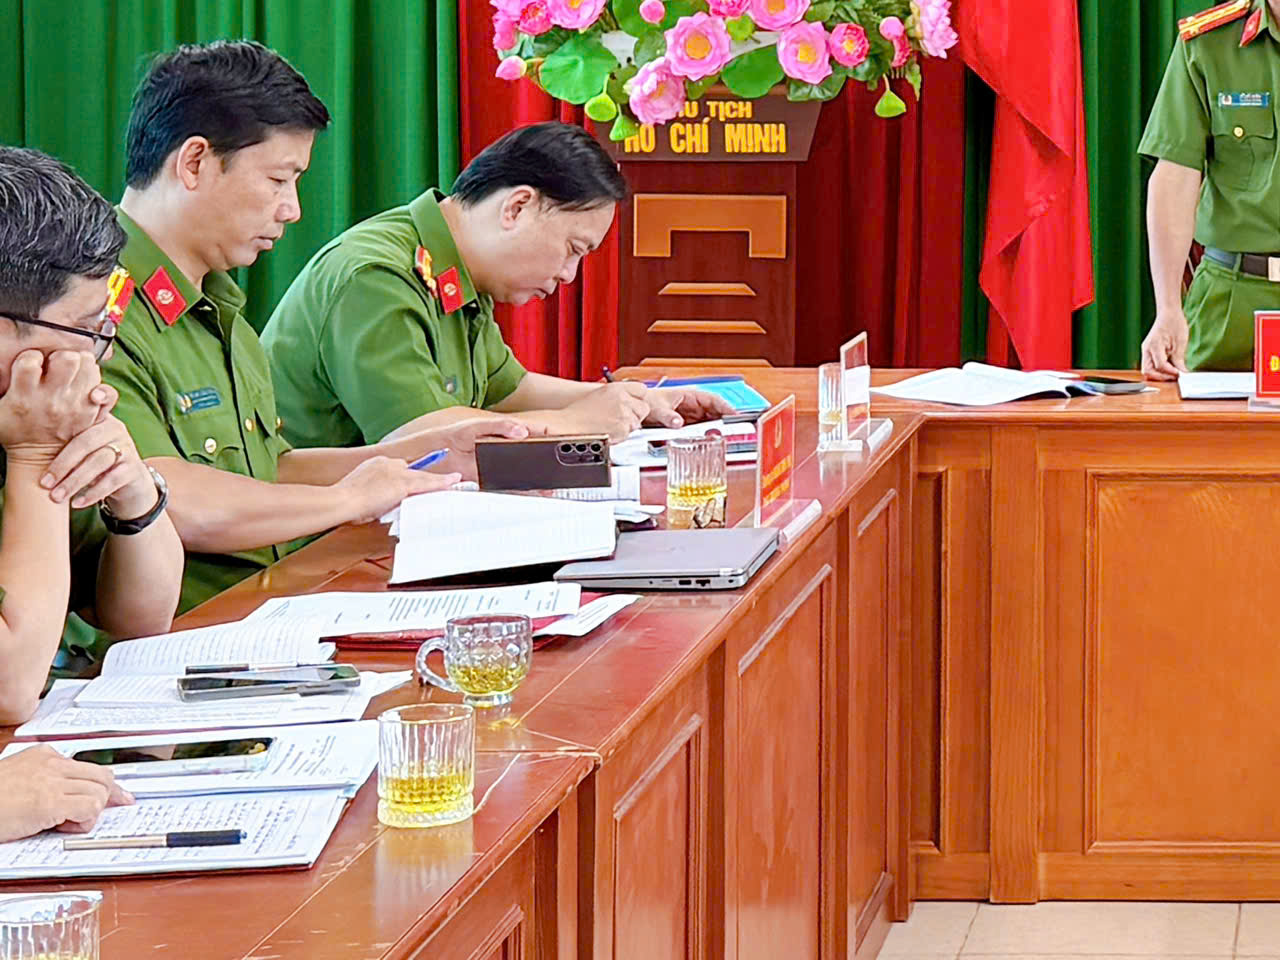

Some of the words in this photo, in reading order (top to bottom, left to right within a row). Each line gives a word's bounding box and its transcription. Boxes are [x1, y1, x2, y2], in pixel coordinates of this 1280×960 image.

[706, 100, 752, 121] TỊCH
[669, 116, 709, 152] CHÍ
[724, 123, 786, 152] MINH
